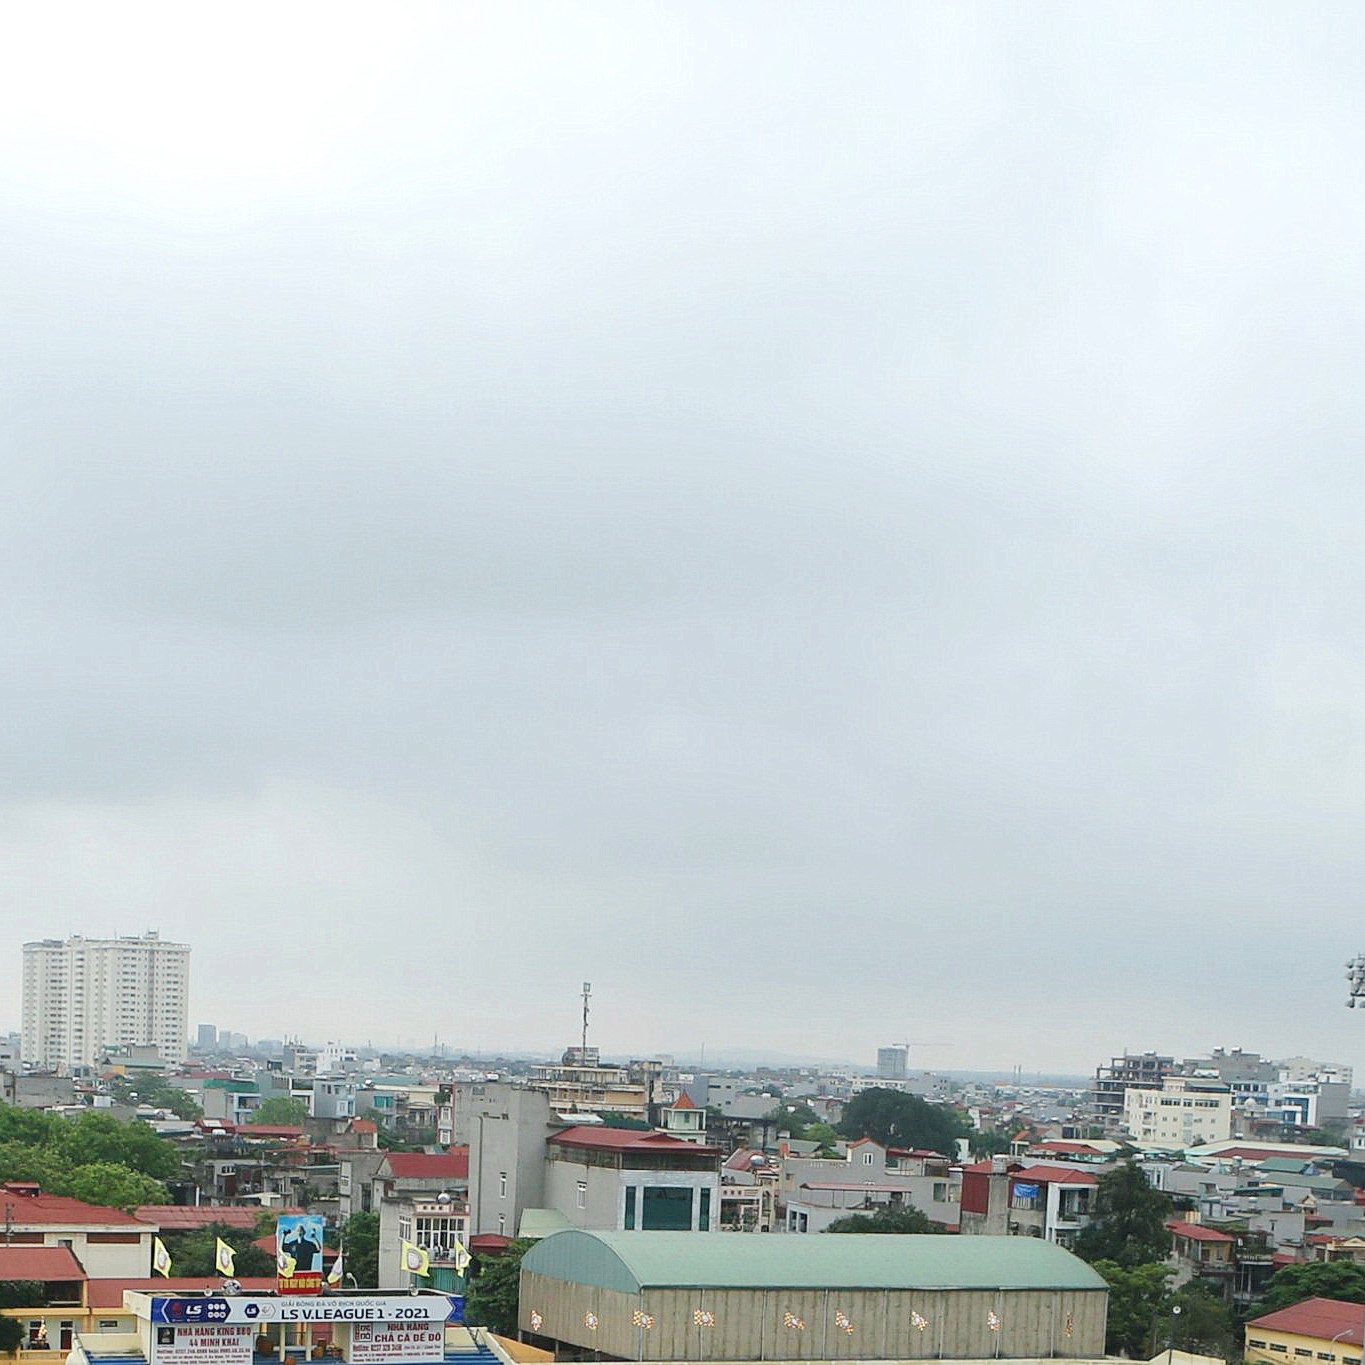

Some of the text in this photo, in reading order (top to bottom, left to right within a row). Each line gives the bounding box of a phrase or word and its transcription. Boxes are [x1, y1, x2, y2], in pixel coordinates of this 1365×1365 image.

[186, 1305, 202, 1314] LS
[281, 1308, 430, 1320] LS V.LEAGUE 1 2021
